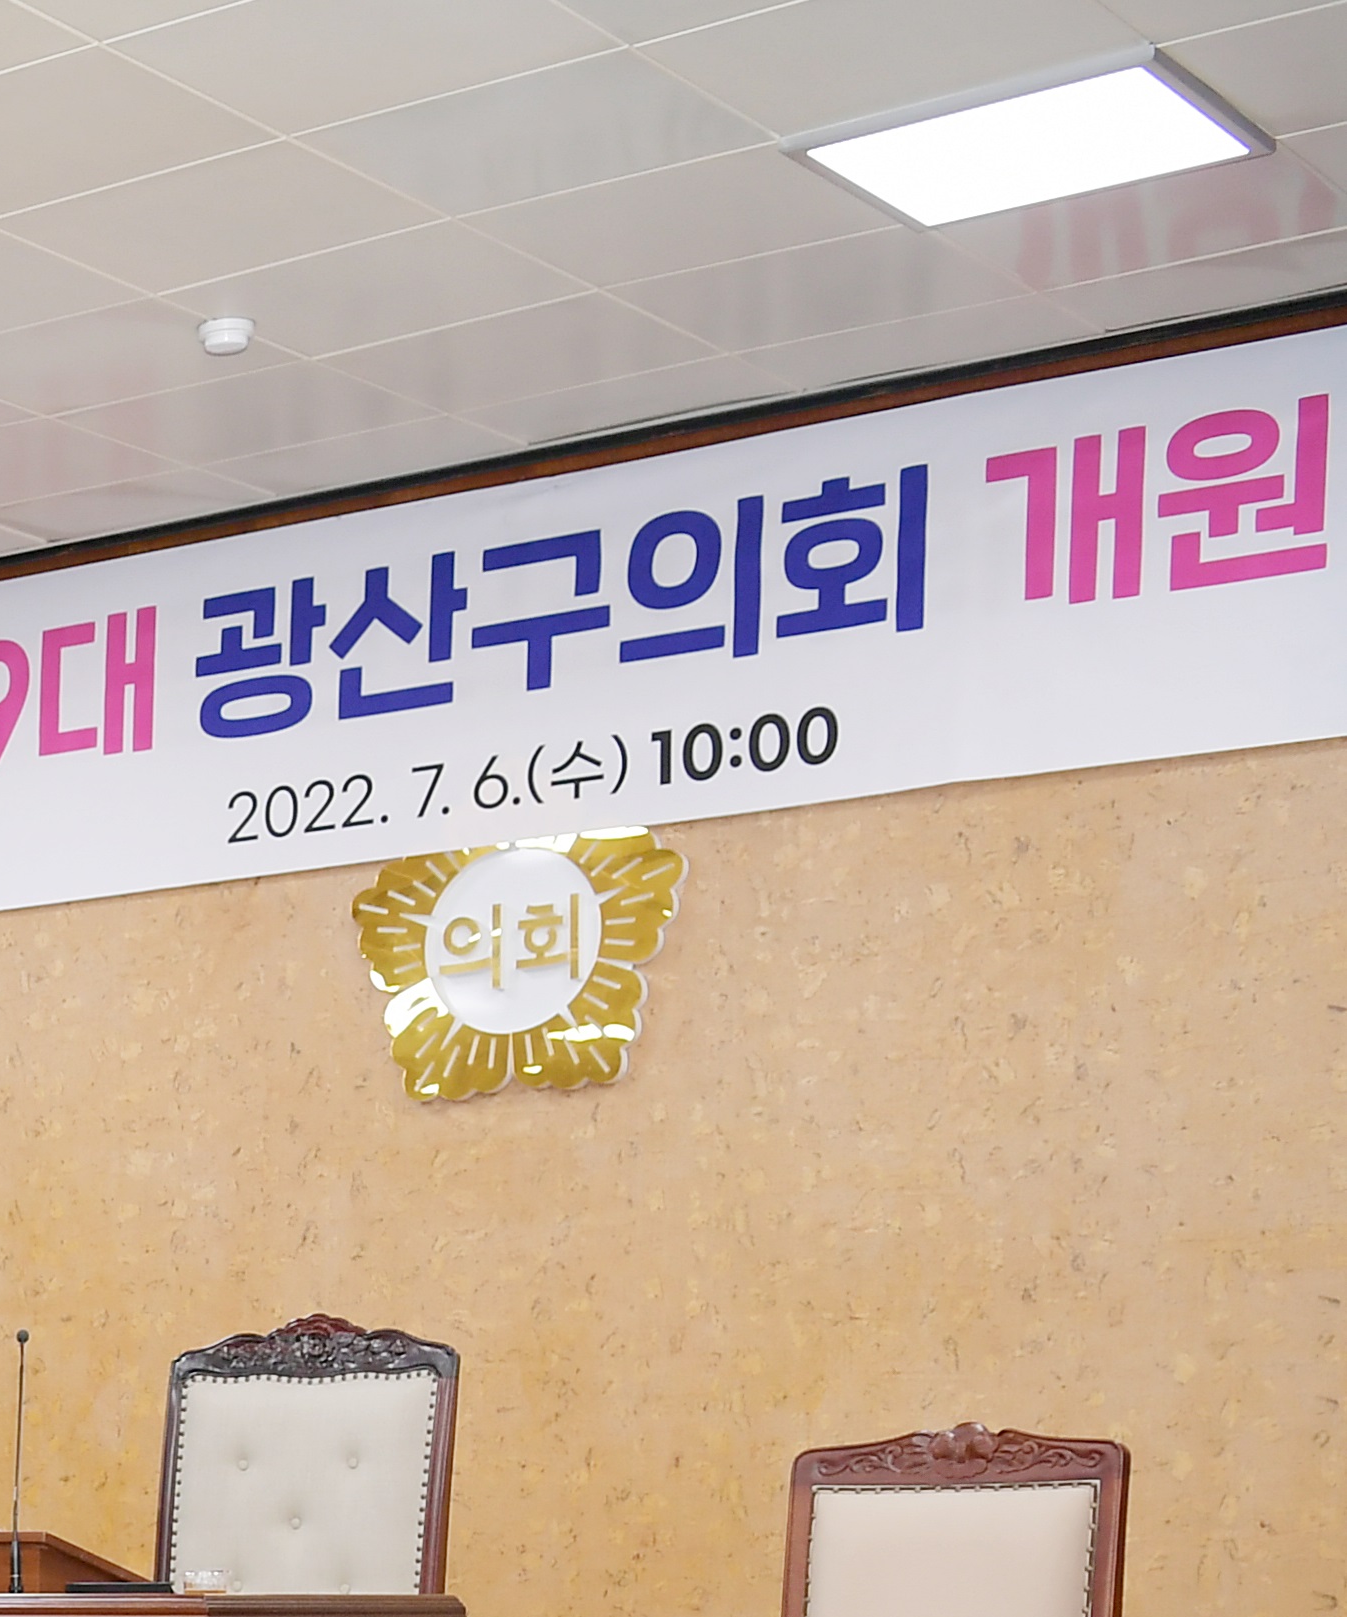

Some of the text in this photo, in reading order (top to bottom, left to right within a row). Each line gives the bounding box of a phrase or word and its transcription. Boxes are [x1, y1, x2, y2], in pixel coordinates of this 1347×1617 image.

[194, 463, 929, 740] 광산구의회
[985, 394, 1330, 604] 개원
[227, 706, 839, 844] 2022. 7. 6.(수) 10:00
[439, 892, 581, 990] 의회
